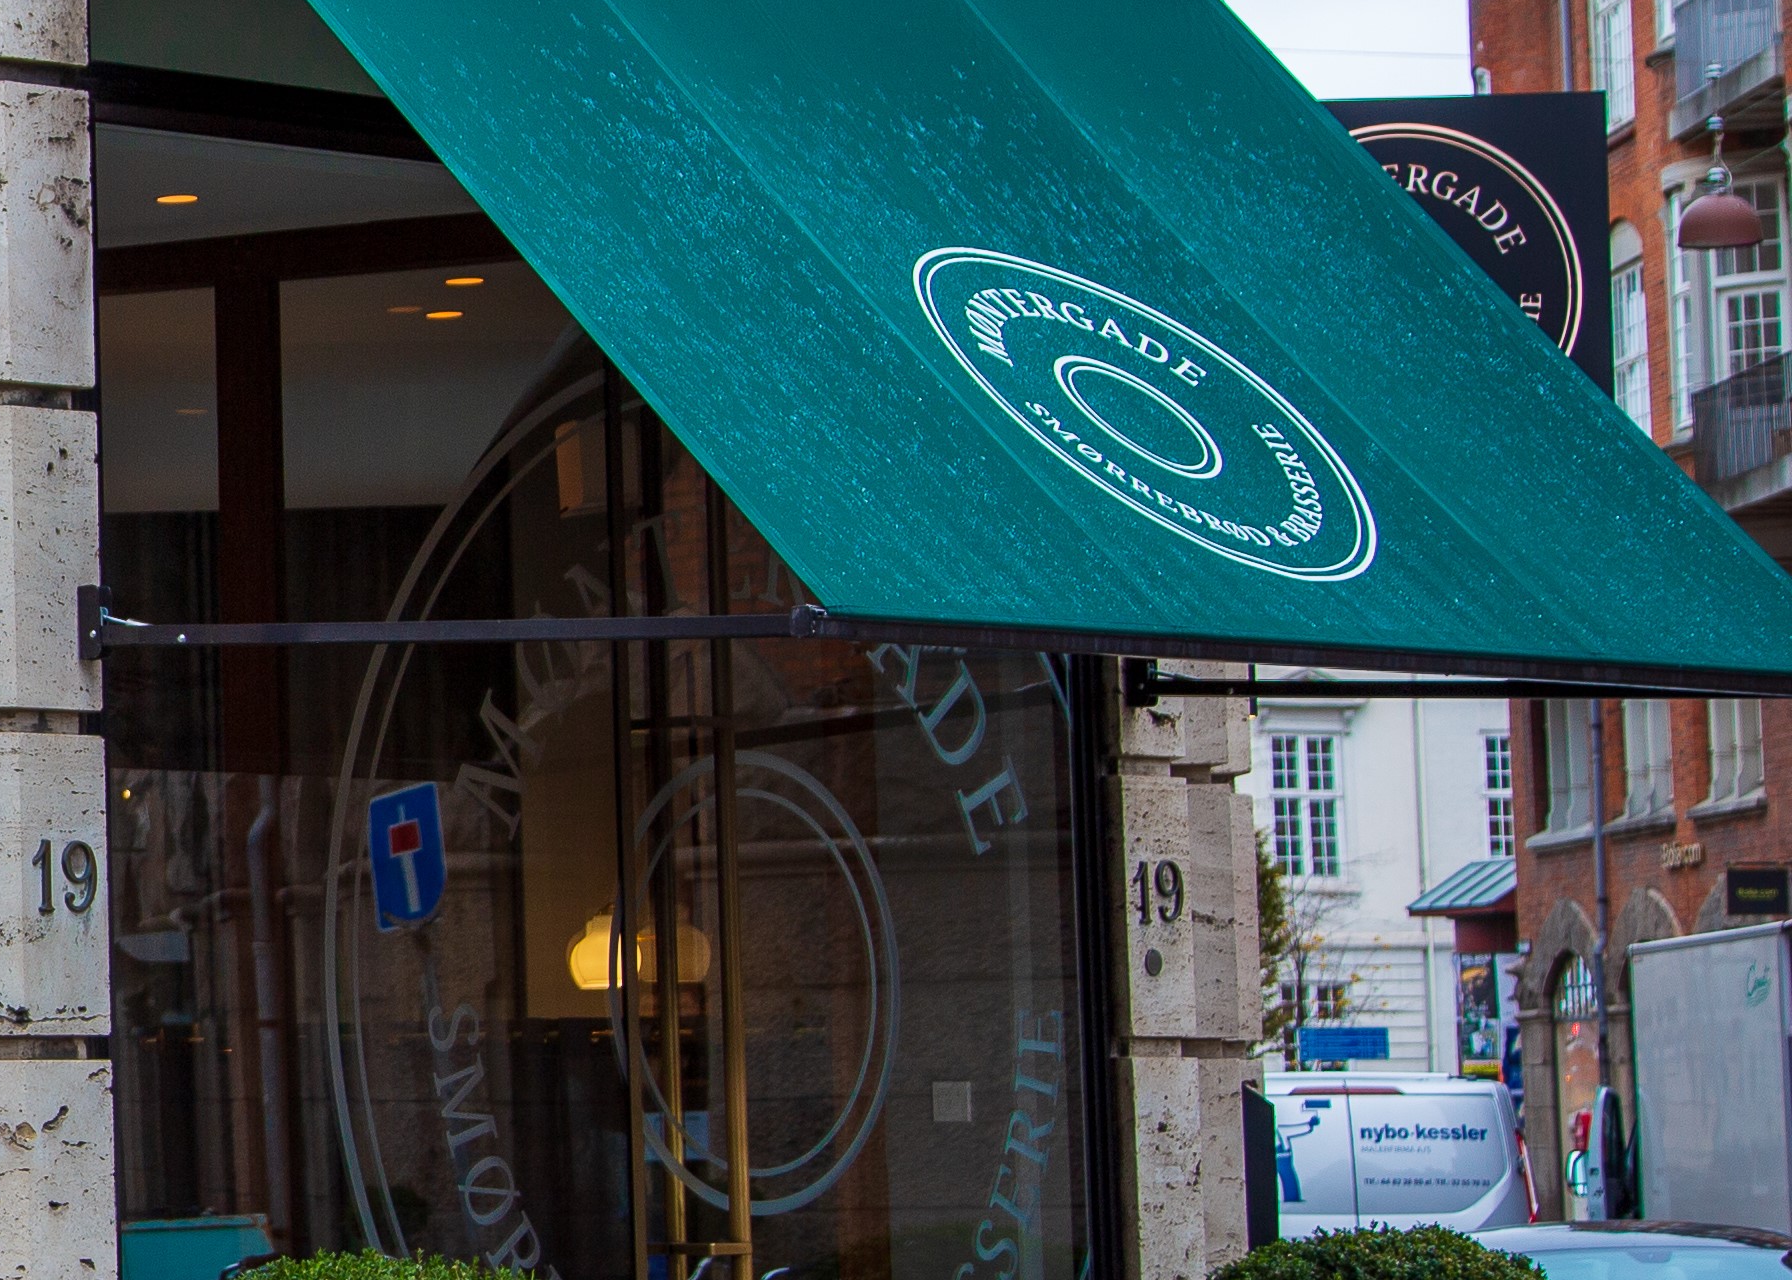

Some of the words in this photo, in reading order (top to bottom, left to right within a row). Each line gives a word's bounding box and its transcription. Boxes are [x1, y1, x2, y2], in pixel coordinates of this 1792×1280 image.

[969, 288, 1208, 387] MØNTERGADE
[1025, 400, 1272, 548] SMØRREBRØD
[1253, 422, 1323, 543] BRASSERIE
[1267, 526, 1297, 548] &
[31, 838, 99, 916] 19
[1132, 859, 1185, 925] 19
